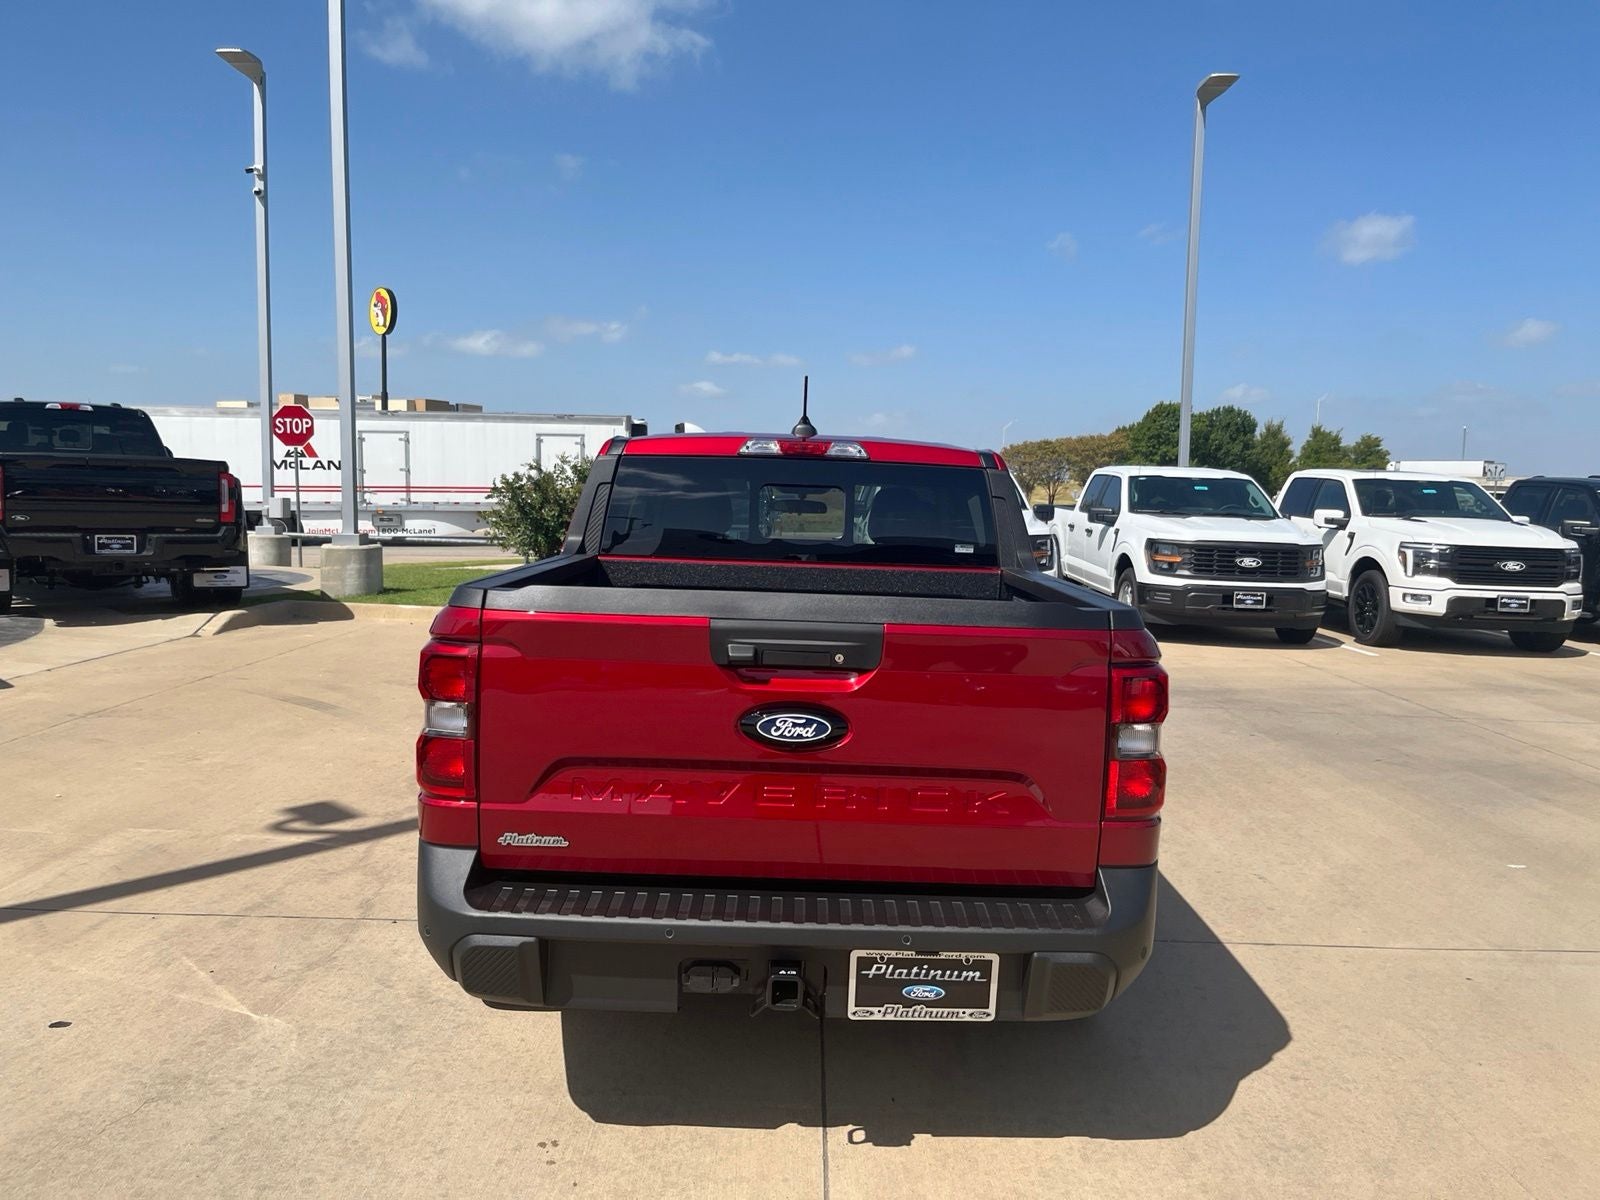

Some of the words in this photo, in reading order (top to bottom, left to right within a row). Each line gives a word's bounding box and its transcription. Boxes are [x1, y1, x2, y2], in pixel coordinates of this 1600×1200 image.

[275, 418, 312, 434] STOP
[273, 460, 342, 470] McLAN
[771, 718, 817, 737] Ford
[571, 777, 1009, 813] MAVERICK
[497, 833, 569, 846] Platinum
[861, 964, 987, 982] Platinum
[910, 987, 937, 998] Ford
[882, 1005, 966, 1019] Platinum
